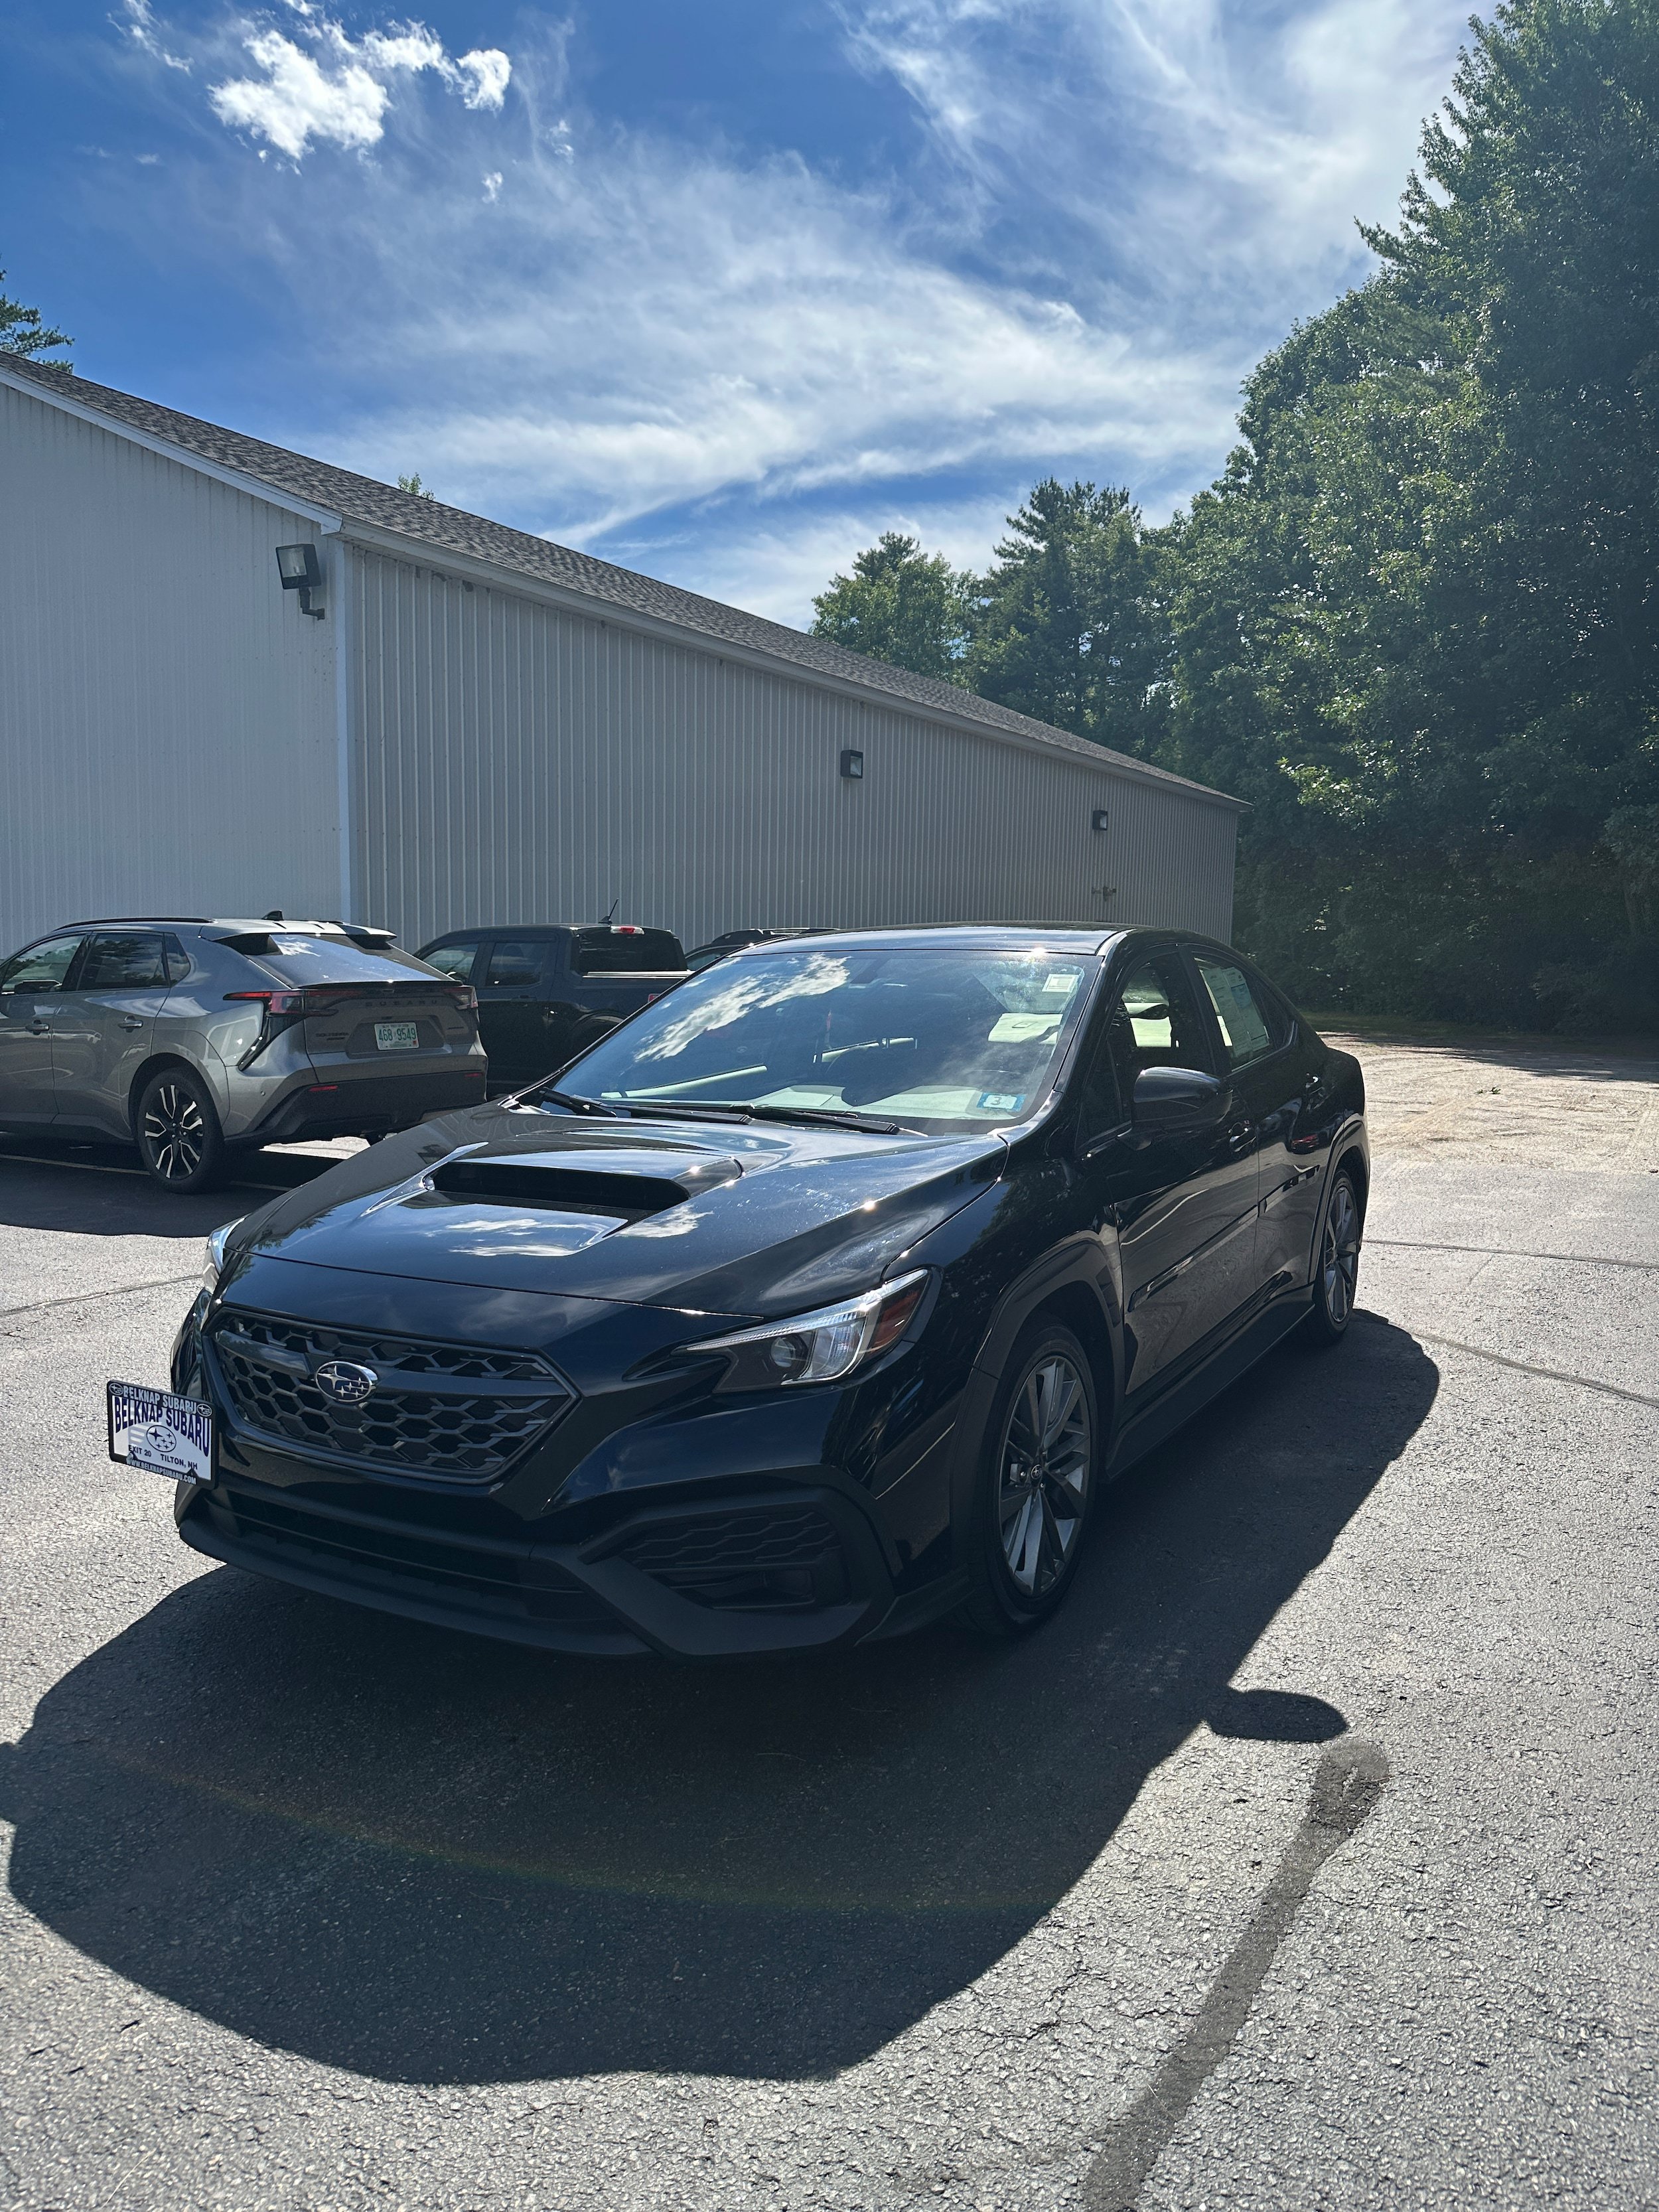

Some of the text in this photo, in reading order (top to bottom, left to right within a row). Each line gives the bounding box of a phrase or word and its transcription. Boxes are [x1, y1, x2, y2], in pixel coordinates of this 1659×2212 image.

[379, 1027, 417, 1041] 468 9549
[990, 1096, 1002, 1106] 3
[123, 1385, 197, 1415] BELKNAP SUBARU
[114, 1396, 210, 1457] BELKNAP SUBARU
[128, 1444, 143, 1455] EXIT
[160, 1453, 186, 1468] TILTON,
[188, 1461, 198, 1470] NH
[127, 1459, 197, 1485] WWW.BELKNAPSUBARU.COM
